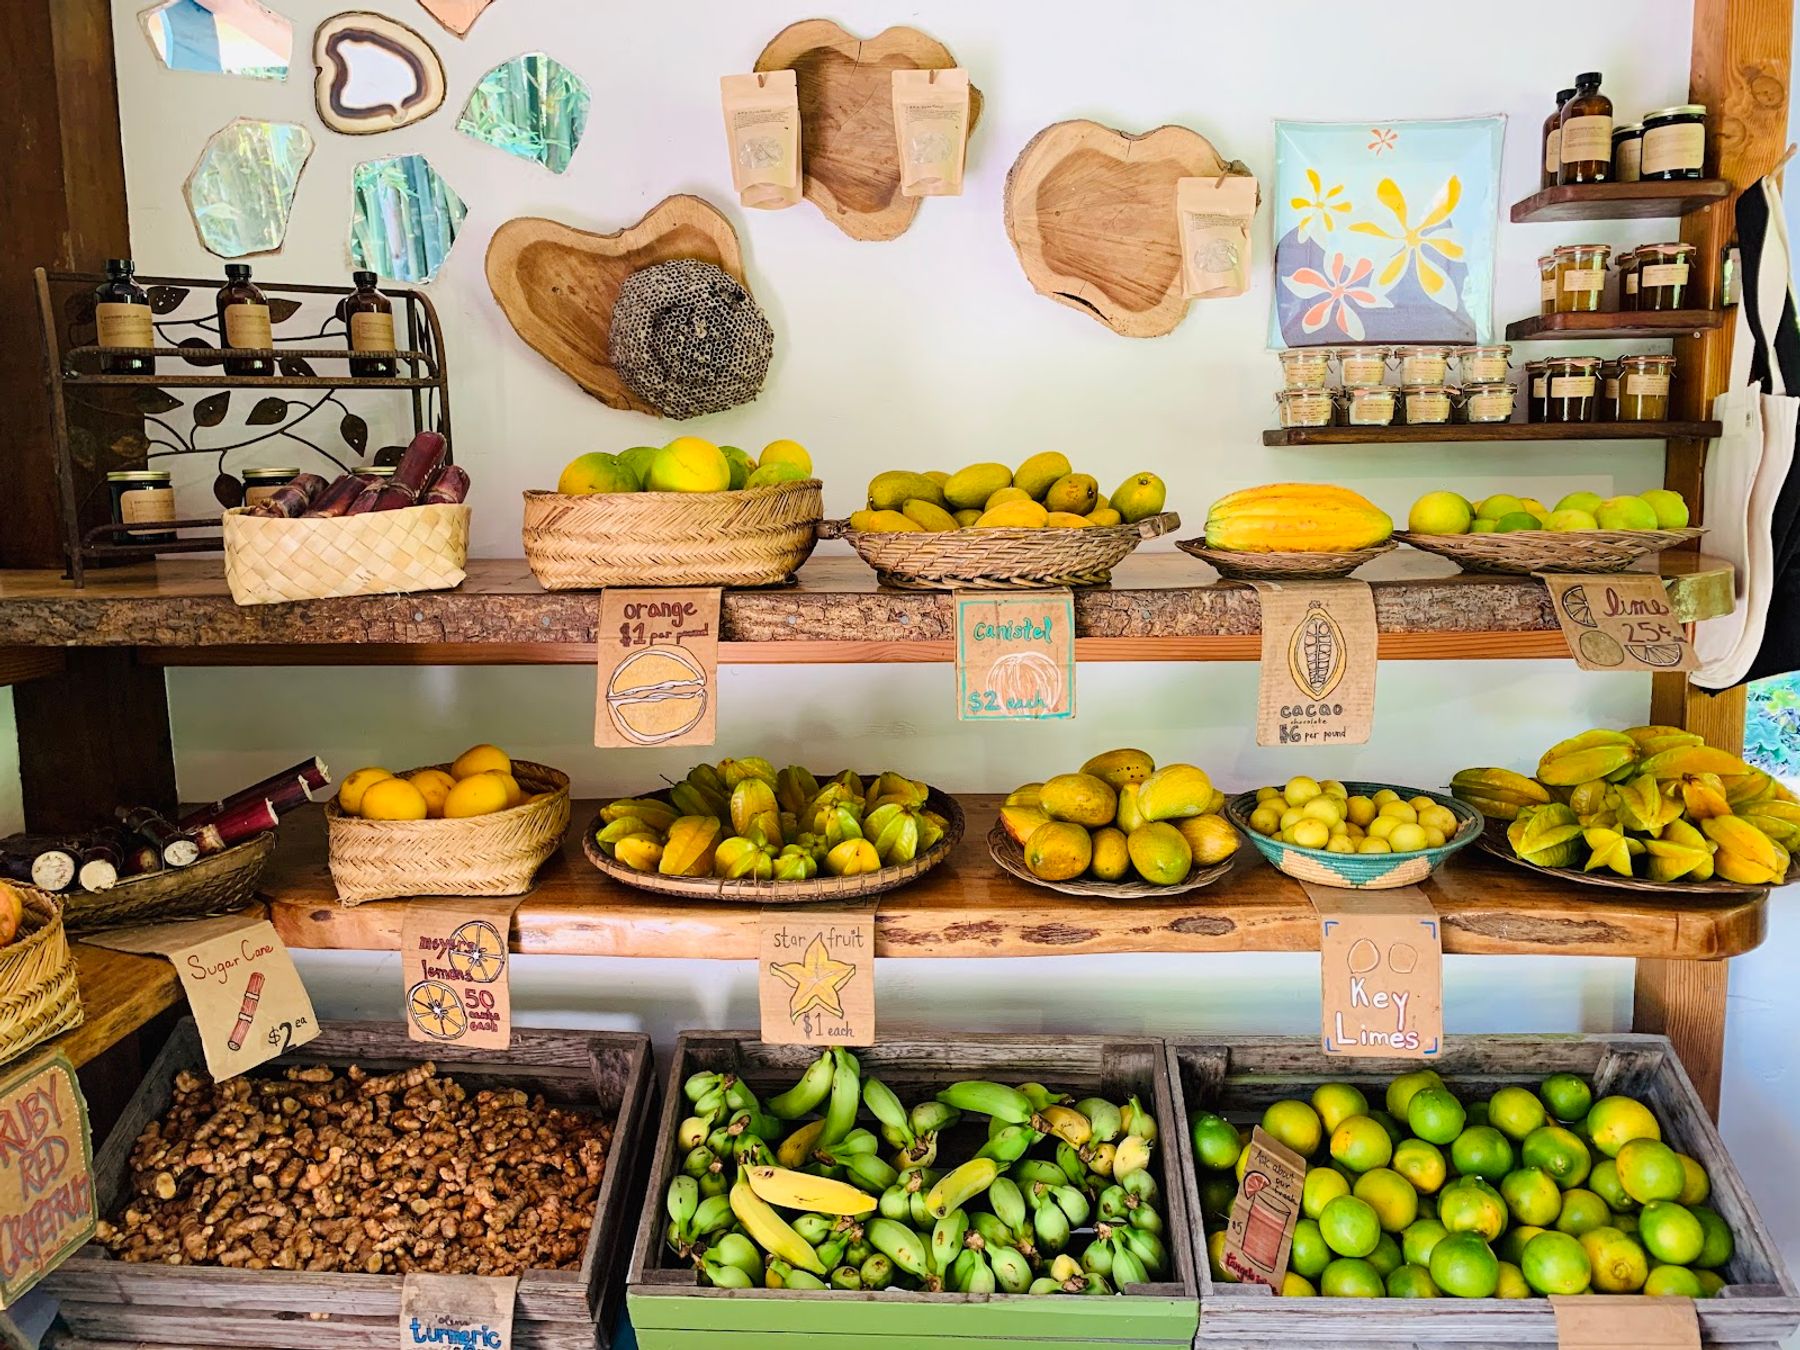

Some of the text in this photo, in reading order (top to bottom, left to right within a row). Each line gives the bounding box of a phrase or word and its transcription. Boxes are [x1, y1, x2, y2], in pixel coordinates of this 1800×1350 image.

[623, 601, 698, 628] orange
[1602, 587, 1670, 617] lime
[619, 622, 646, 647] $1
[968, 689, 1048, 715] $2 each
[1279, 723, 1346, 744] $6 per pound
[1290, 717, 1328, 725] chocolate
[773, 926, 865, 949] star fruit
[187, 939, 274, 984] Sugar Cane
[421, 959, 474, 982] lemons
[464, 988, 495, 1009] 50
[1350, 975, 1411, 1032] Key
[268, 1016, 308, 1054] $2 ea
[802, 1012, 855, 1039] $1 each
[1335, 1011, 1420, 1050] Limes
[18, 1135, 70, 1202] RED
[409, 1317, 502, 1349] turmeric
